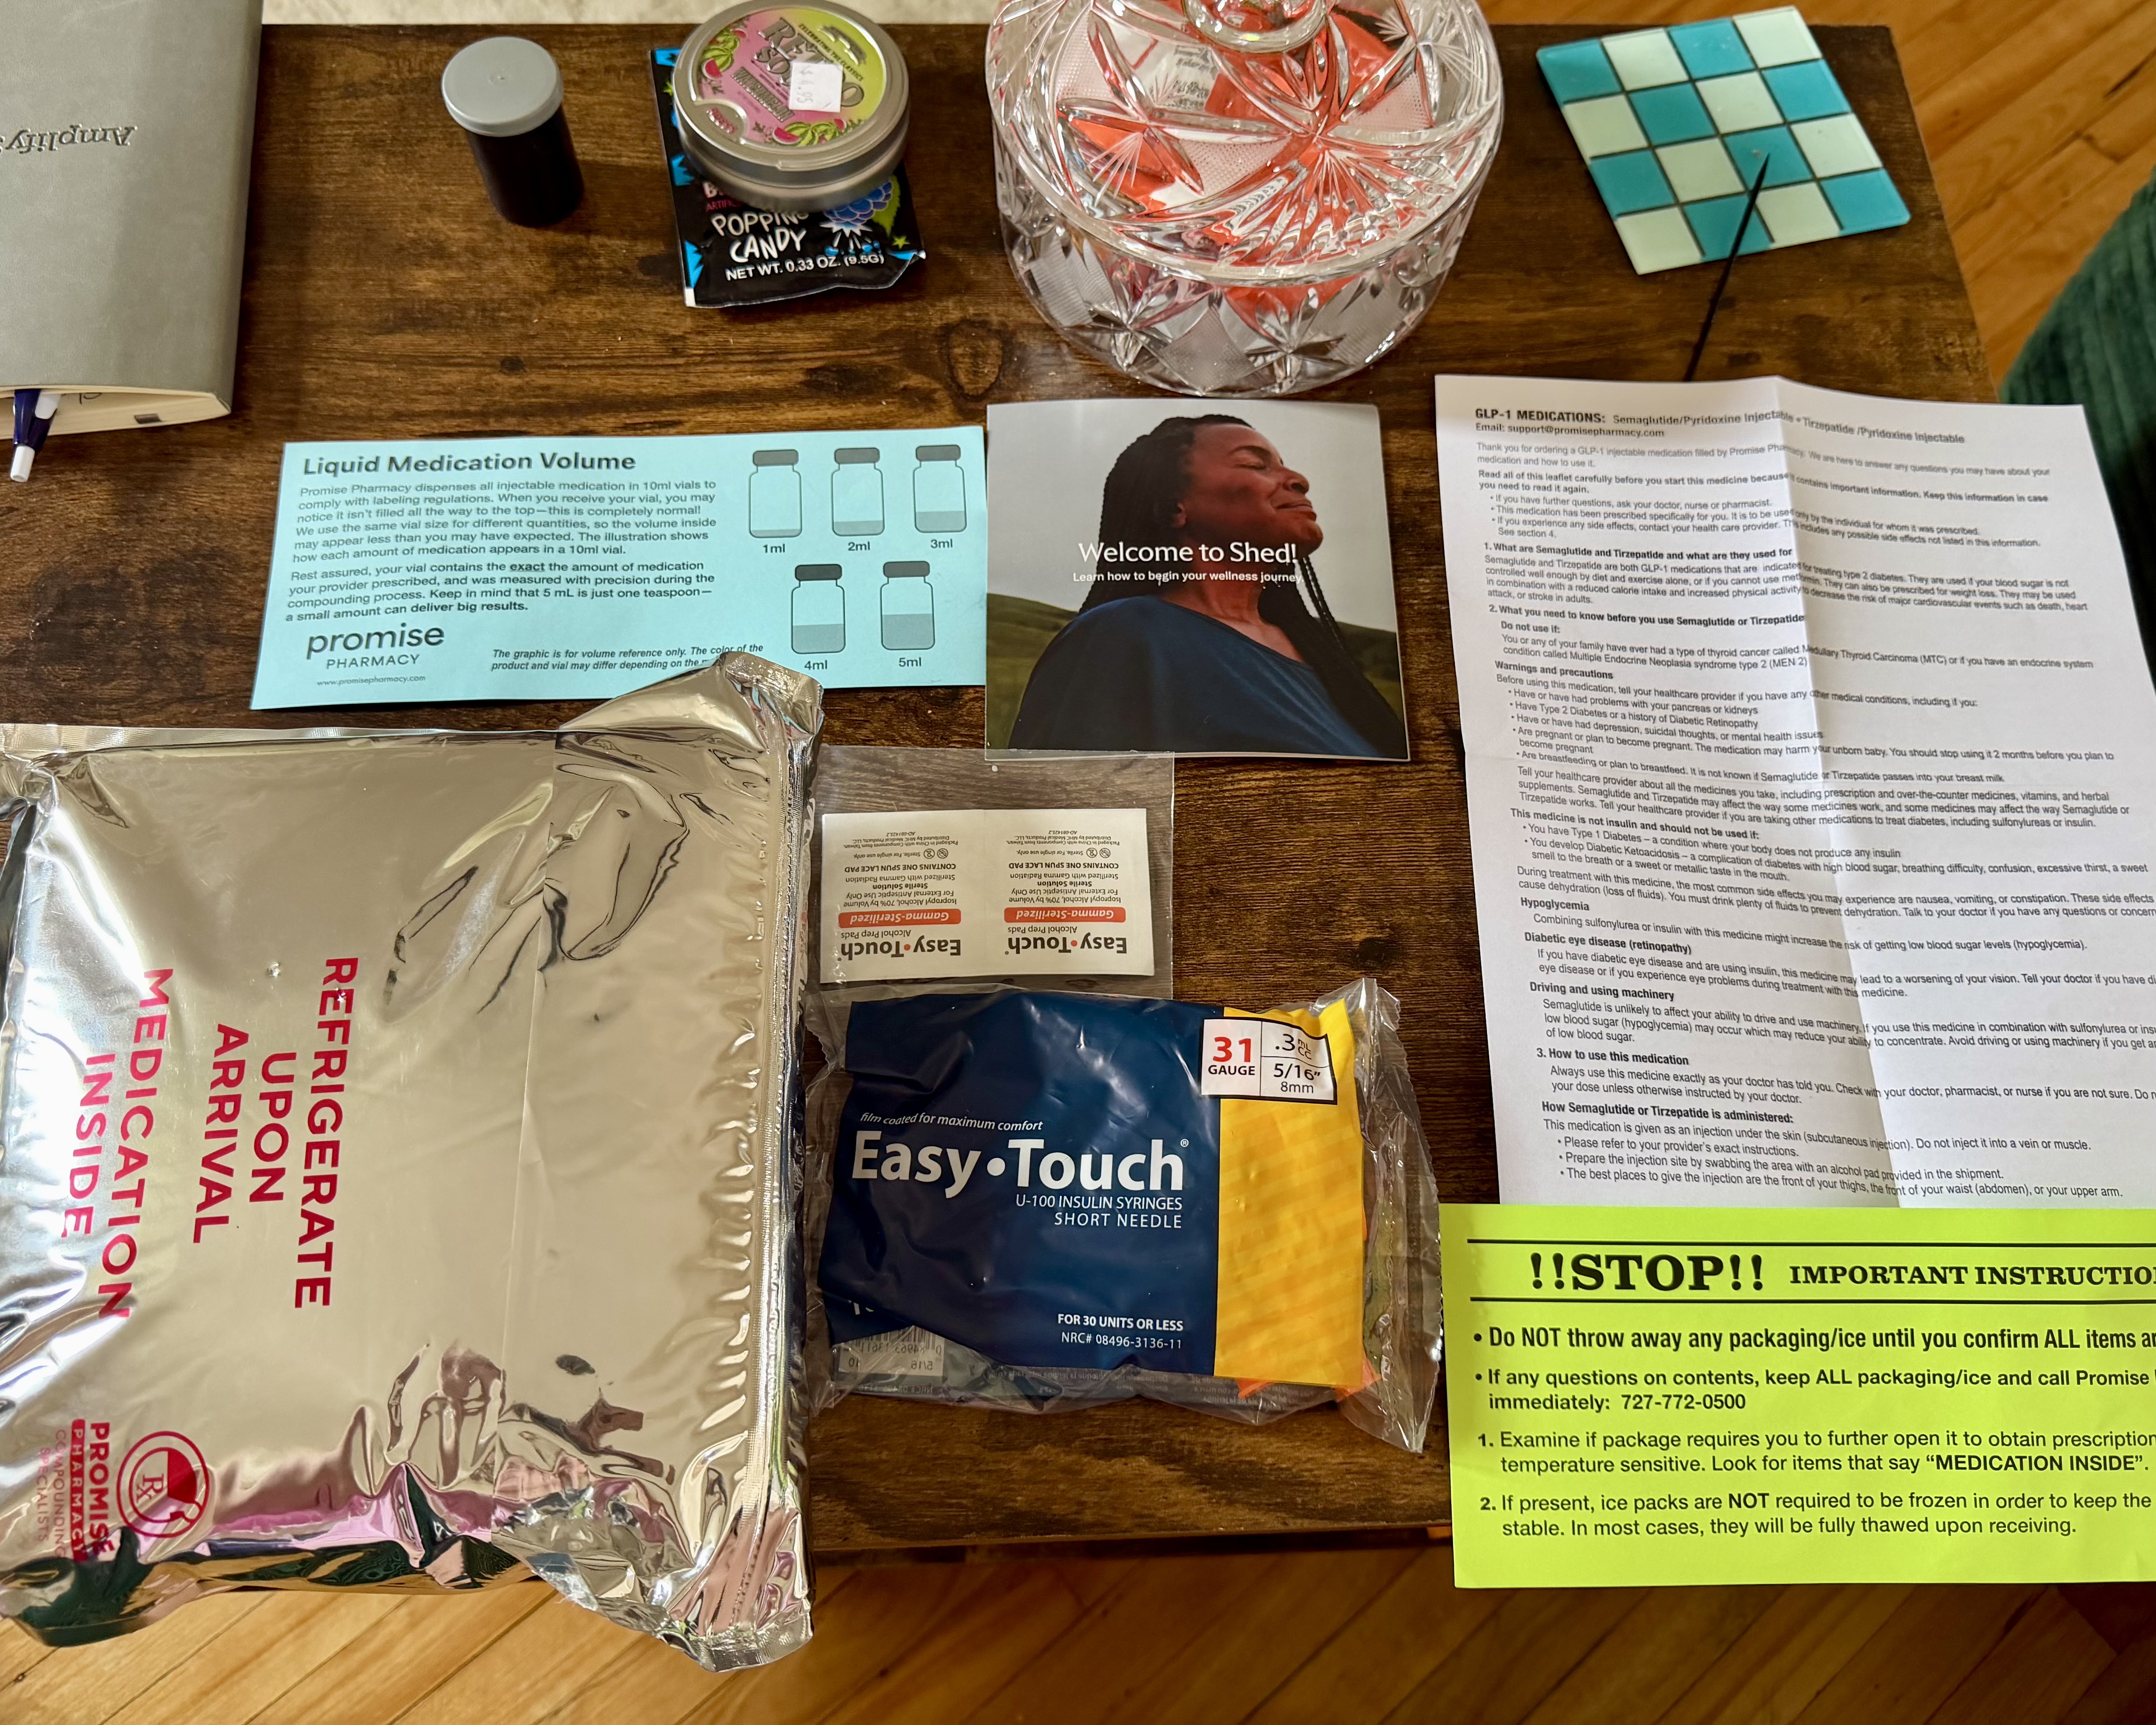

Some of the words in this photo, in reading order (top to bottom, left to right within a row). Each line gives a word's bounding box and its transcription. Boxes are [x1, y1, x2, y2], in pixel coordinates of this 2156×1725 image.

[5, 123, 138, 154] Amplify
[729, 226, 807, 263] CANDY
[725, 265, 755, 281] NET
[757, 263, 783, 276] WT.
[785, 258, 814, 273] 0.33
[816, 255, 841, 268] OZ.
[844, 253, 884, 267] (9.5G)
[1475, 408, 1511, 420] GLP-1
[1517, 410, 1605, 423] MEDICATIONS:
[304, 456, 380, 478] Liquid
[388, 453, 532, 472] Medication
[540, 452, 636, 470] Volume
[300, 486, 348, 497] Promise
[351, 484, 412, 494] Pharmacy
[415, 483, 477, 493] dispenses
[480, 481, 494, 491] all
[497, 481, 555, 492] injectable
[559, 481, 625, 491] medication
[629, 482, 639, 491] in
[643, 481, 671, 491] 10ml
[674, 480, 701, 490] vials
[704, 480, 716, 489] to
[763, 543, 785, 553] 1ml
[848, 541, 870, 551] 2ml
[930, 538, 953, 549] 3ml
[1079, 541, 1194, 562] Welcome
[1198, 544, 1225, 562] to
[1230, 542, 1296, 564] Shed!
[1073, 573, 1105, 581] Learn
[1107, 571, 1131, 581] how
[1133, 571, 1146, 580] to
[1148, 570, 1180, 583] begin
[1181, 573, 1208, 582] your
[1209, 570, 1258, 581] wellness
[306, 622, 444, 660] promise
[493, 649, 510, 658] The
[513, 649, 550, 660] graphic
[553, 649, 561, 658] is
[564, 649, 579, 658] for
[582, 649, 616, 658] volume
[619, 649, 662, 658] reference
[665, 647, 686, 658] only.
[691, 646, 708, 655] The
[749, 644, 763, 653] the
[326, 654, 420, 669] PHARMACY
[804, 659, 828, 671] 4ml
[898, 657, 921, 668] 5ml
[1494, 660, 1538, 674] Warnings
[1540, 666, 1557, 675] and
[1559, 668, 1614, 679] precautions
[317, 675, 426, 686] www.promisepharmacy.com
[1036, 895, 1044, 904] by
[1090, 895, 1121, 904] Isopropyl
[1520, 897, 1590, 911] Hypoglycemia
[850, 912, 949, 925] Gamma-Sterilized
[1016, 909, 1114, 920] Gamma-Sterilized
[841, 932, 859, 940] Pads
[861, 929, 879, 938] Prep
[881, 929, 911, 938] Alcohol
[1524, 932, 1566, 944] Diabetic
[1568, 937, 1586, 946] eye
[1588, 936, 1626, 948] disease
[1629, 939, 1692, 955] (retinopathy)
[1530, 981, 1566, 995] Driving
[1569, 984, 1588, 994] and
[1591, 986, 1619, 998] using
[1621, 988, 1675, 1002] machinery
[1212, 1036, 1251, 1063] 31
[1536, 1047, 1546, 1058] 3.
[1548, 1048, 1572, 1059] How
[1574, 1049, 1586, 1060] to
[1588, 1052, 1607, 1061] use
[1609, 1051, 1629, 1062] this
[1632, 1053, 1689, 1065] medication
[1208, 1065, 1255, 1076] GAUGE
[1280, 1081, 1314, 1094] 8mm
[1542, 1101, 1565, 1112] How
[1568, 1102, 1635, 1116] Semaglutide
[1638, 1107, 1649, 1116] or
[1650, 1105, 1709, 1119] Tirzepatide
[1711, 1108, 1721, 1119] is
[1723, 1110, 1794, 1123] administered:
[249, 1052, 297, 1203] UPON
[860, 1112, 882, 1122] film
[883, 1113, 919, 1125] coated
[918, 1112, 936, 1123] for
[937, 1116, 995, 1130] maximum
[997, 1120, 1044, 1131] comfort
[193, 1024, 249, 1244] ARRIVAL
[295, 957, 360, 1308] REFRIGERATE
[61, 1053, 116, 1238] INSIDE
[98, 969, 174, 1318] MEDICATION
[1016, 1194, 1055, 1207] U-100
[1059, 1195, 1113, 1209] INSULIN
[1115, 1197, 1182, 1210] SYRINGES
[1054, 1212, 1110, 1226] SHORT
[1117, 1213, 1181, 1229] NEEDLE
[1529, 1251, 1764, 1293] !!STOP!!
[1789, 1264, 1968, 1286] IMPORTANT
[1975, 1265, 2156, 1286] INSTRUCTIO
[1058, 1313, 1081, 1325] FOR
[1083, 1315, 1097, 1326] 30
[1099, 1316, 1134, 1329] UNITS
[1136, 1318, 1153, 1330] OR
[1156, 1319, 1184, 1331] LESS
[1061, 1331, 1092, 1344] NRC#
[1096, 1334, 1181, 1349] 08496-3136-11
[1489, 1326, 1515, 1347] Do
[1522, 1327, 1561, 1347] NOT
[1566, 1327, 1624, 1348] throw
[1631, 1332, 1682, 1352] away
[1689, 1332, 1723, 1352] any
[1729, 1327, 1866, 1352] packaging/ice
[1872, 1327, 1915, 1348] until
[1921, 1332, 1957, 1352] you
[1963, 1328, 2039, 1348] confirm
[2044, 1329, 2080, 1349] ALL
[2086, 1329, 2136, 1349] items
[1489, 1393, 1610, 1414] immediately:
[1621, 1393, 1746, 1410] 727-772-0500
[36, 1447, 51, 1542] SPECIALISTS
[53, 1429, 67, 1558] COMPOUNDING
[71, 1428, 84, 1551] PHARMACY
[89, 1422, 116, 1555] PROMISE
